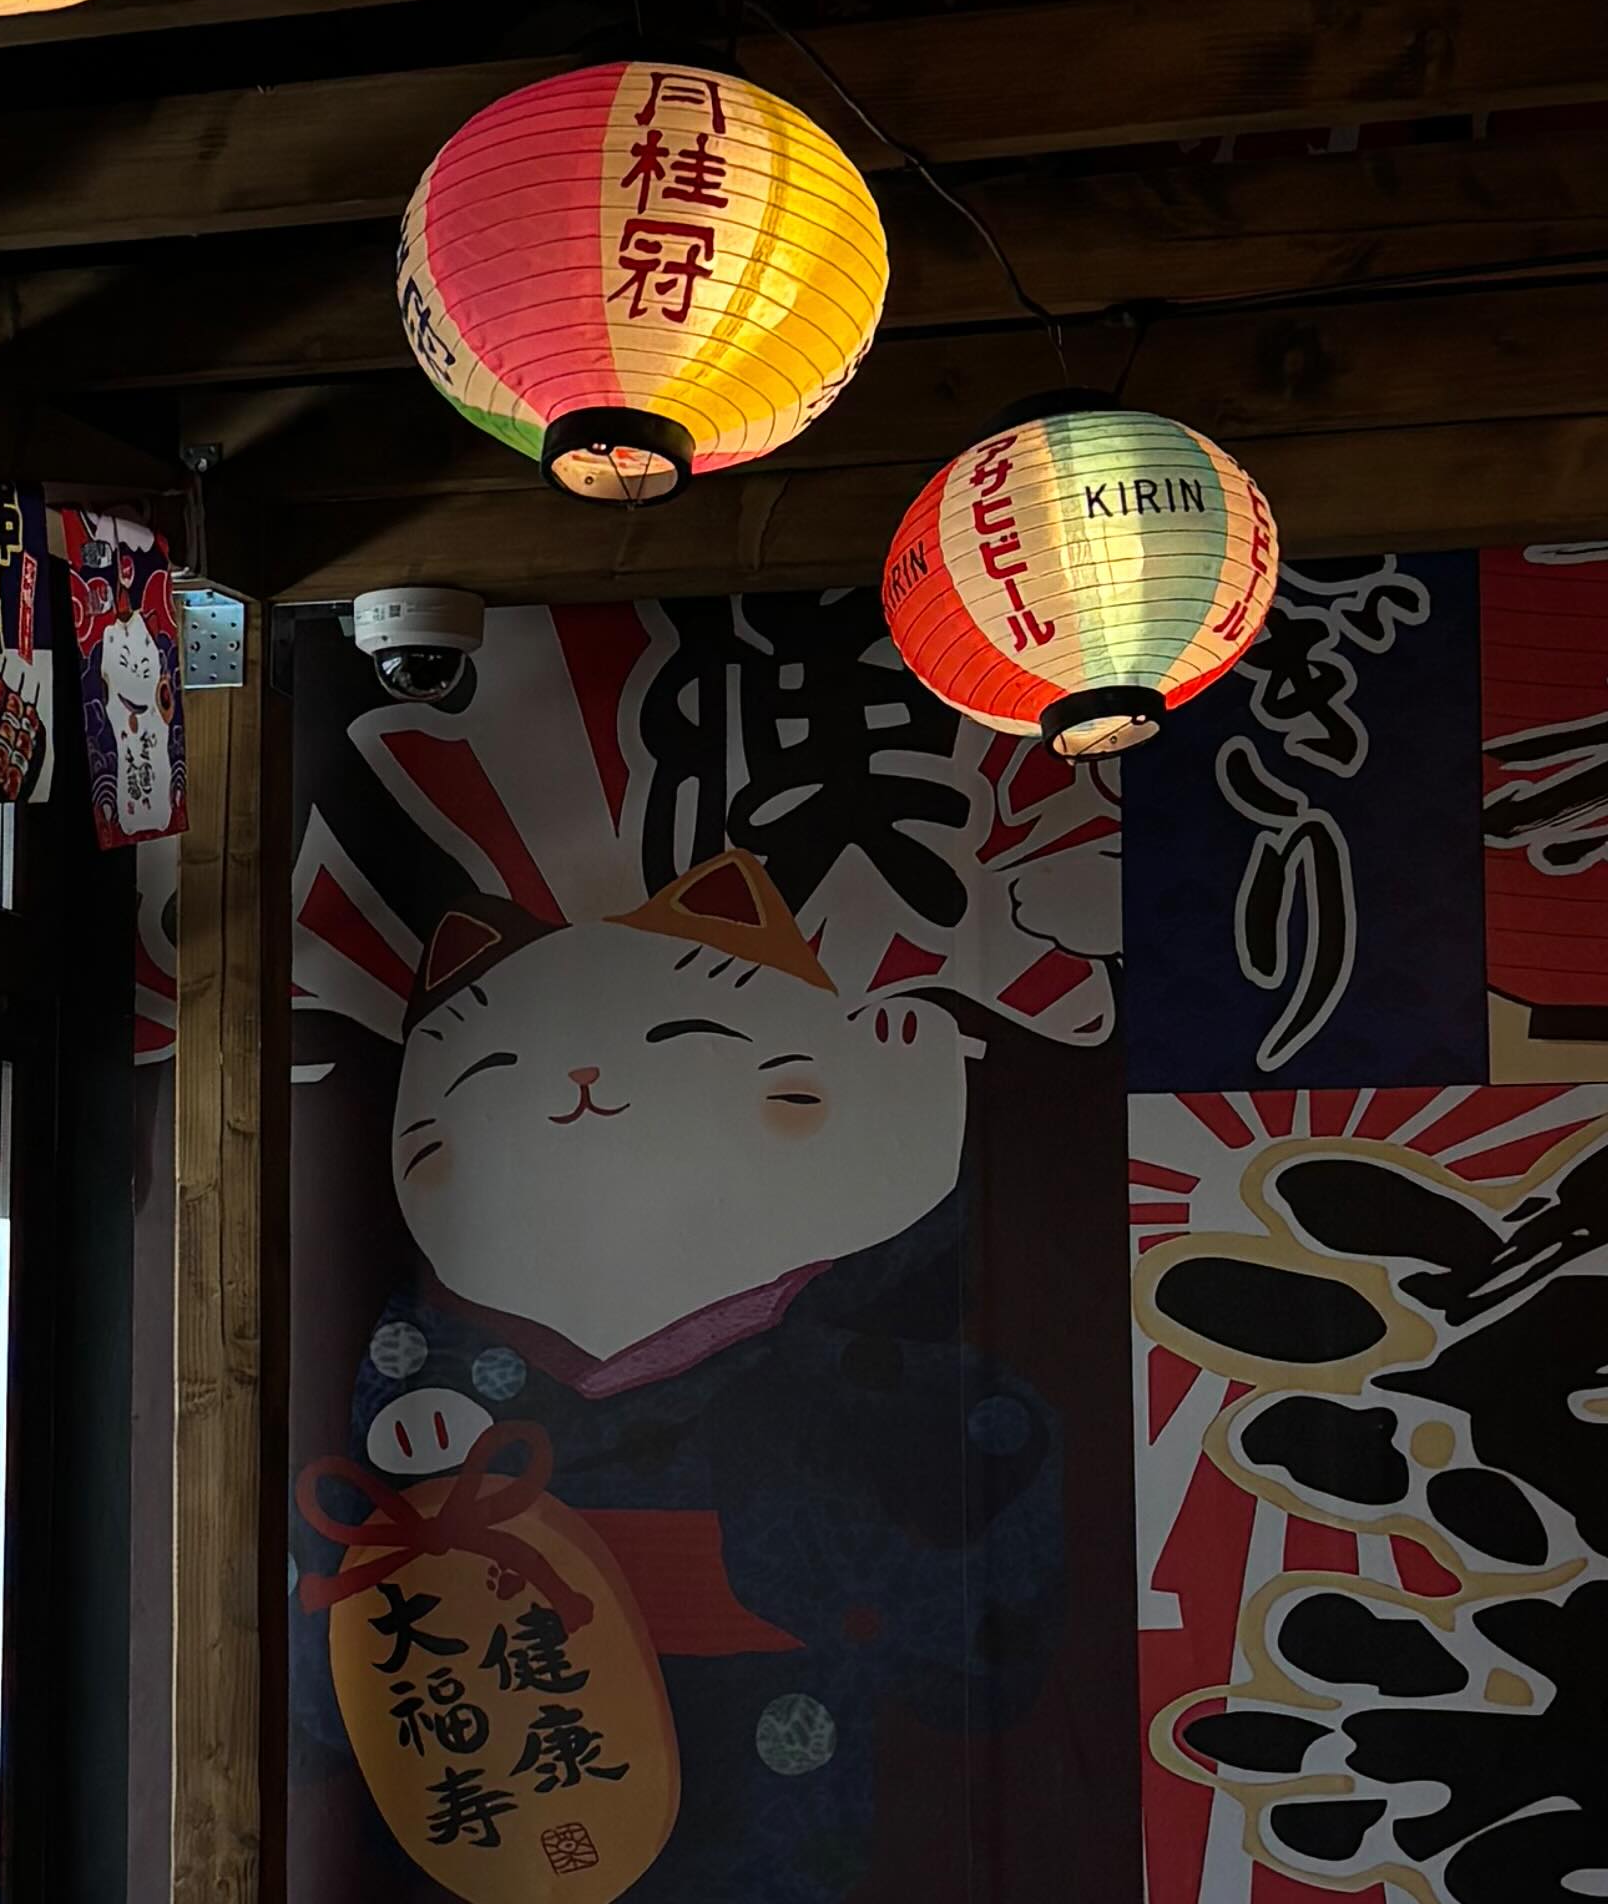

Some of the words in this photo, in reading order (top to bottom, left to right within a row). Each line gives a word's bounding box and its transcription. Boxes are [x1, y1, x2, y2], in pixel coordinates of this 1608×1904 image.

[606, 71, 729, 324] 月桂冠
[968, 433, 1056, 654] アサヒビール
[1084, 476, 1207, 520] KIRIN
[1212, 480, 1272, 642] ヒビール
[367, 1583, 519, 1849] 大福寿
[480, 1601, 631, 1795] 健康
